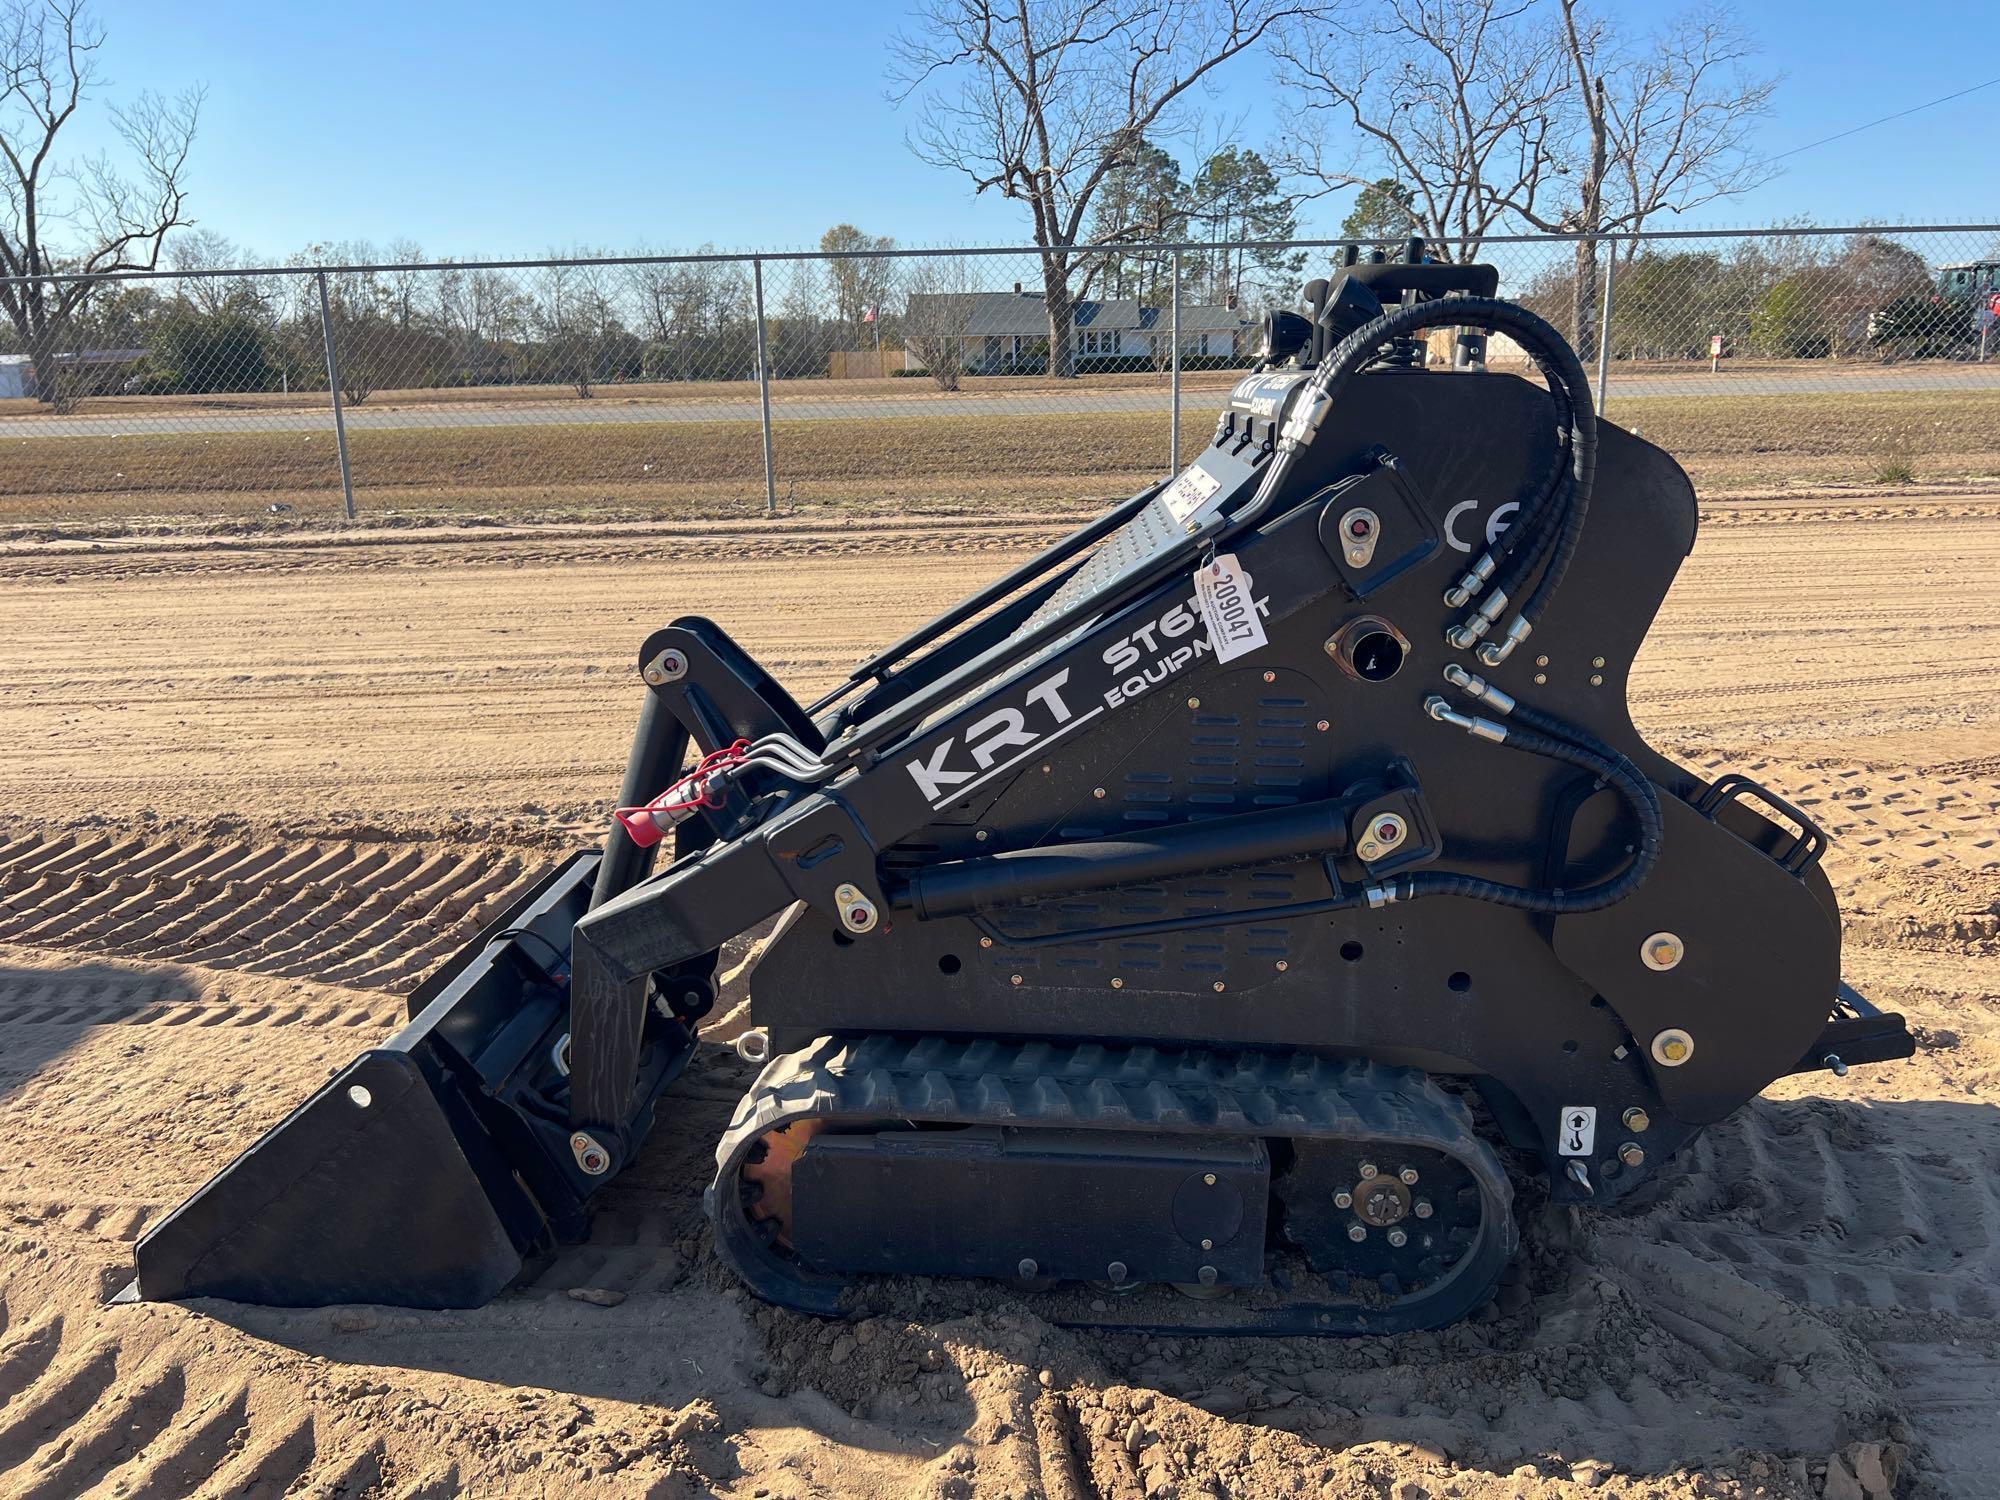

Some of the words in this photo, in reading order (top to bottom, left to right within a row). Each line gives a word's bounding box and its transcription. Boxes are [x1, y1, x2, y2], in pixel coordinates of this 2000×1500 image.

[1103, 595, 1271, 710] EQUIPMT
[1213, 573, 1254, 641] 209047
[905, 667, 1070, 802] KRT
